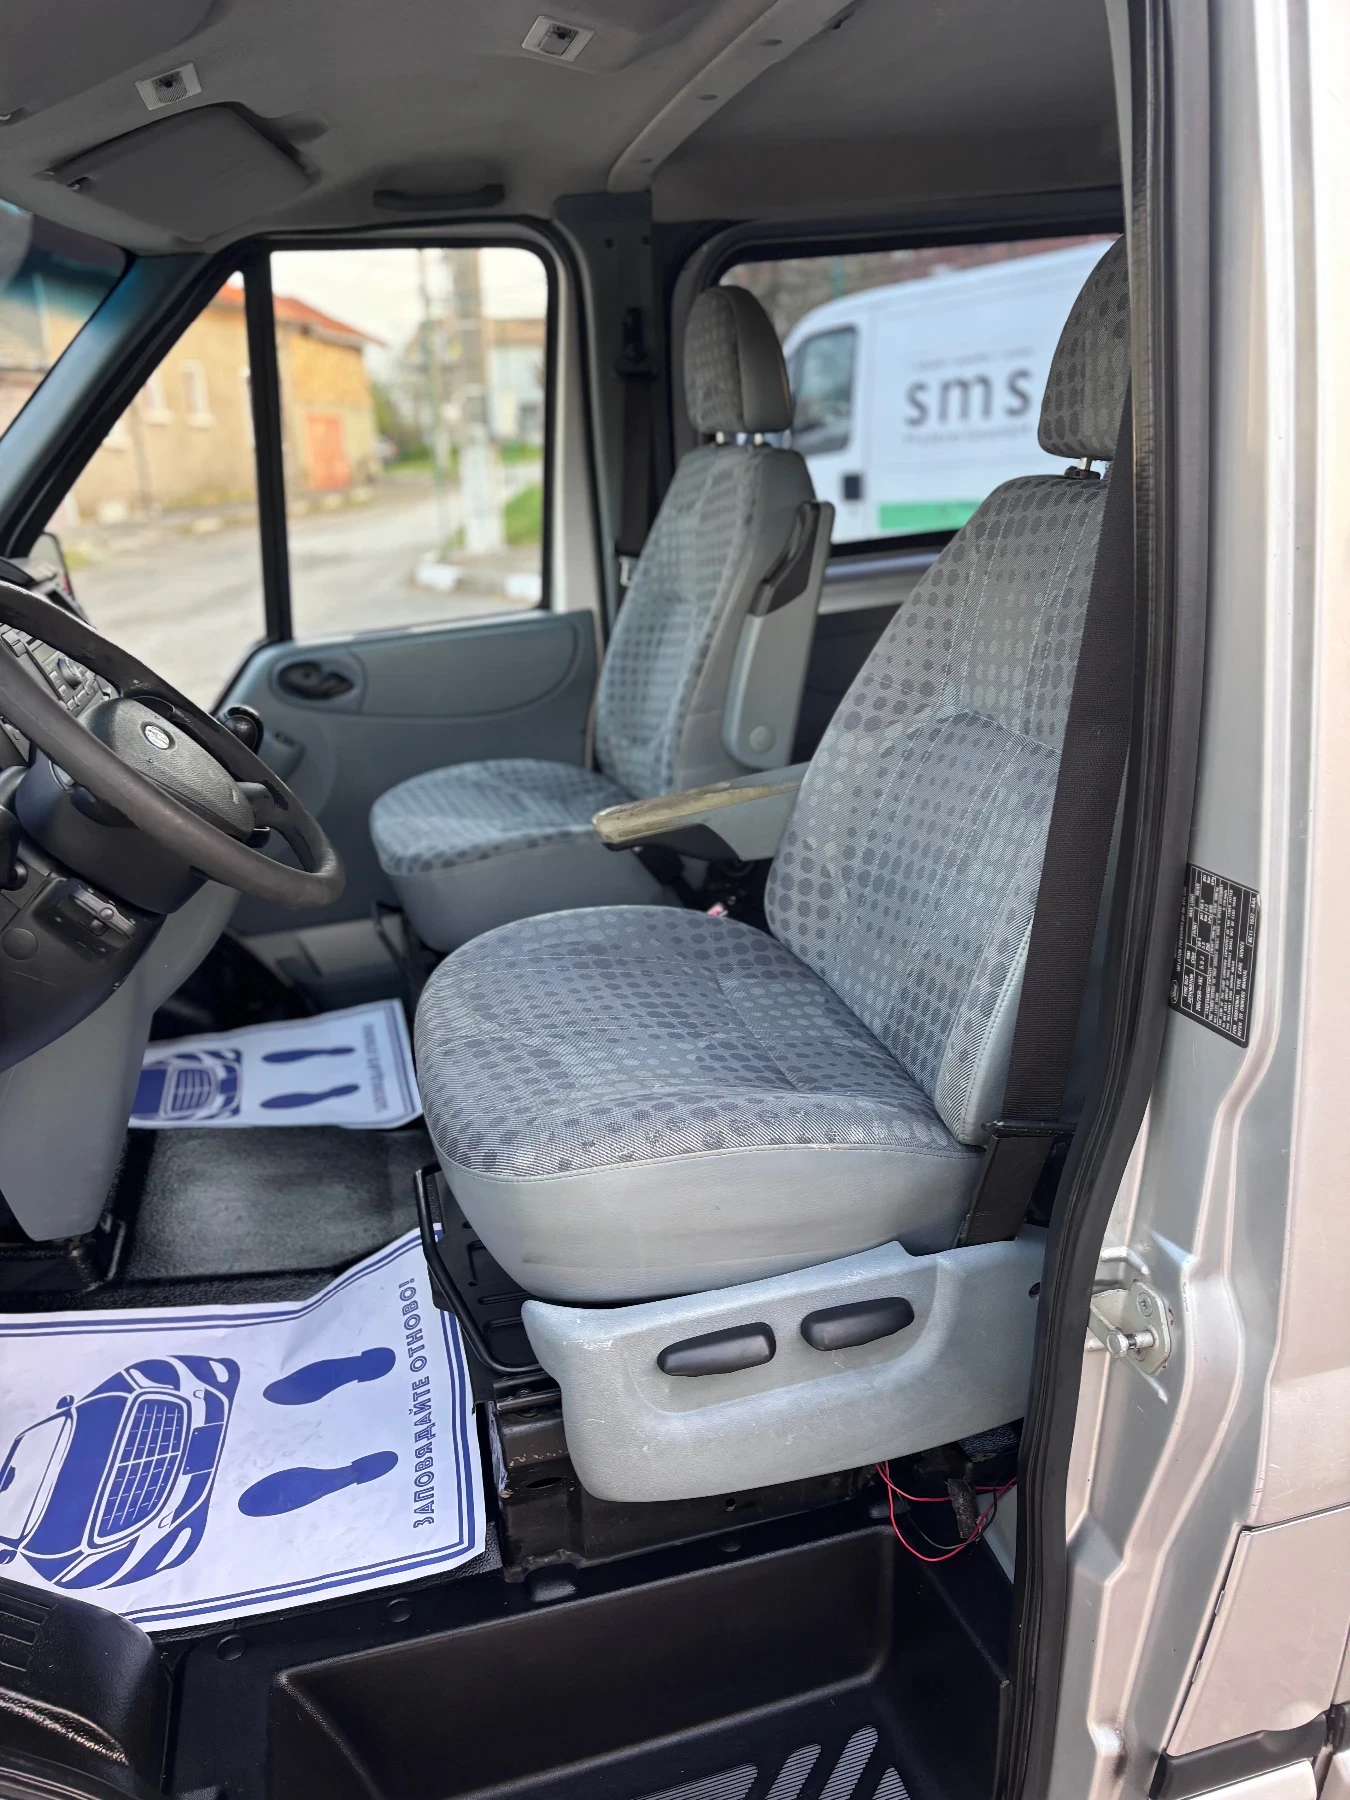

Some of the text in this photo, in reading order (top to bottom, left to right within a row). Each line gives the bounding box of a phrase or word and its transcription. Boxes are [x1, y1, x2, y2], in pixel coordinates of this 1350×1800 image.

[905, 367, 1034, 427] sms
[398, 1277, 436, 1528] ЗАПОВЯДАЙТЕ ОТНОВО!
